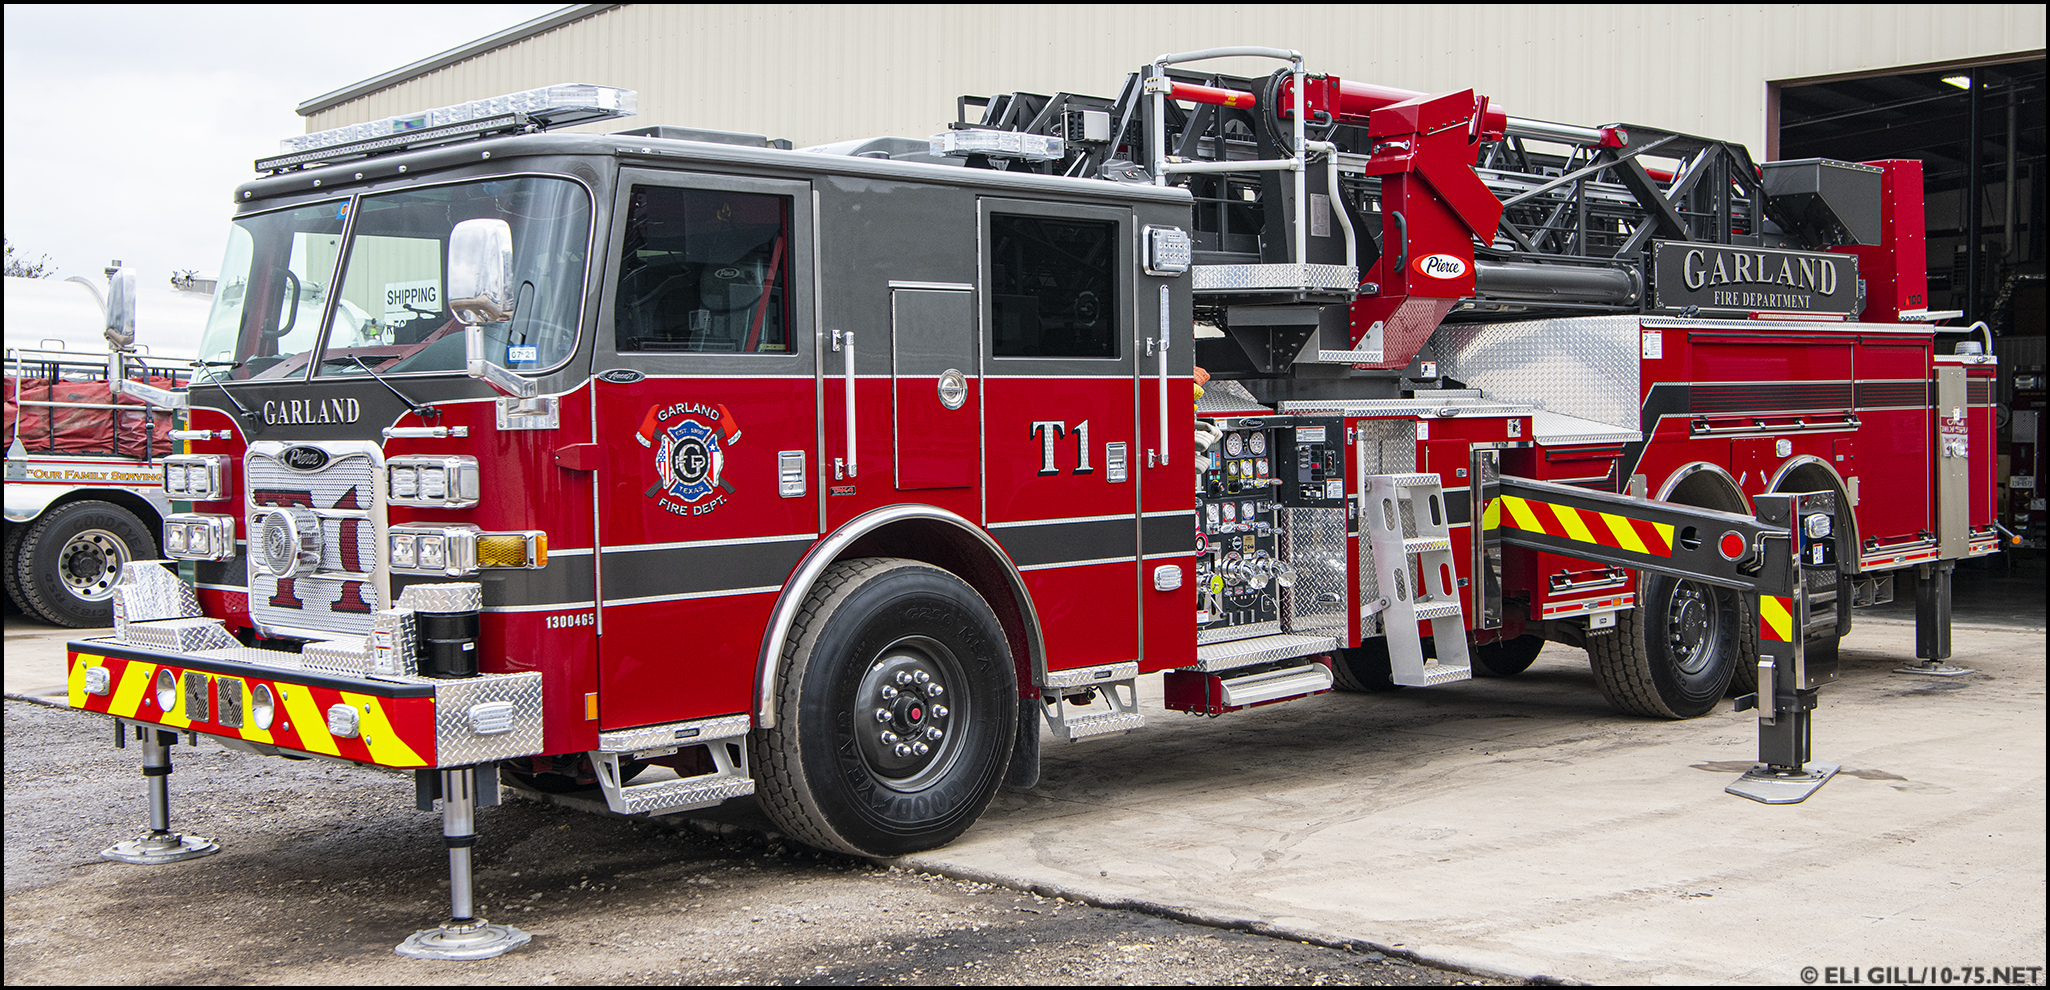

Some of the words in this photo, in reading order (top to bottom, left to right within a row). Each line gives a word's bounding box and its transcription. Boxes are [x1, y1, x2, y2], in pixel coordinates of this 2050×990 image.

[1426, 256, 1460, 274] Pierce
[1683, 249, 1838, 296] GARLAND
[387, 286, 436, 305] SHIPPING
[1714, 290, 1739, 306] FIRE
[1742, 293, 1811, 309] DEPARTMENT
[263, 398, 360, 426] GARLAND
[657, 402, 720, 422] GARLAND
[1029, 419, 1094, 477] T1
[678, 485, 704, 495] TEXAS
[657, 497, 688, 517] FIRE
[692, 495, 728, 517] DEPT.
[72, 515, 147, 560] GOODYEA
[545, 612, 595, 629] 1300465
